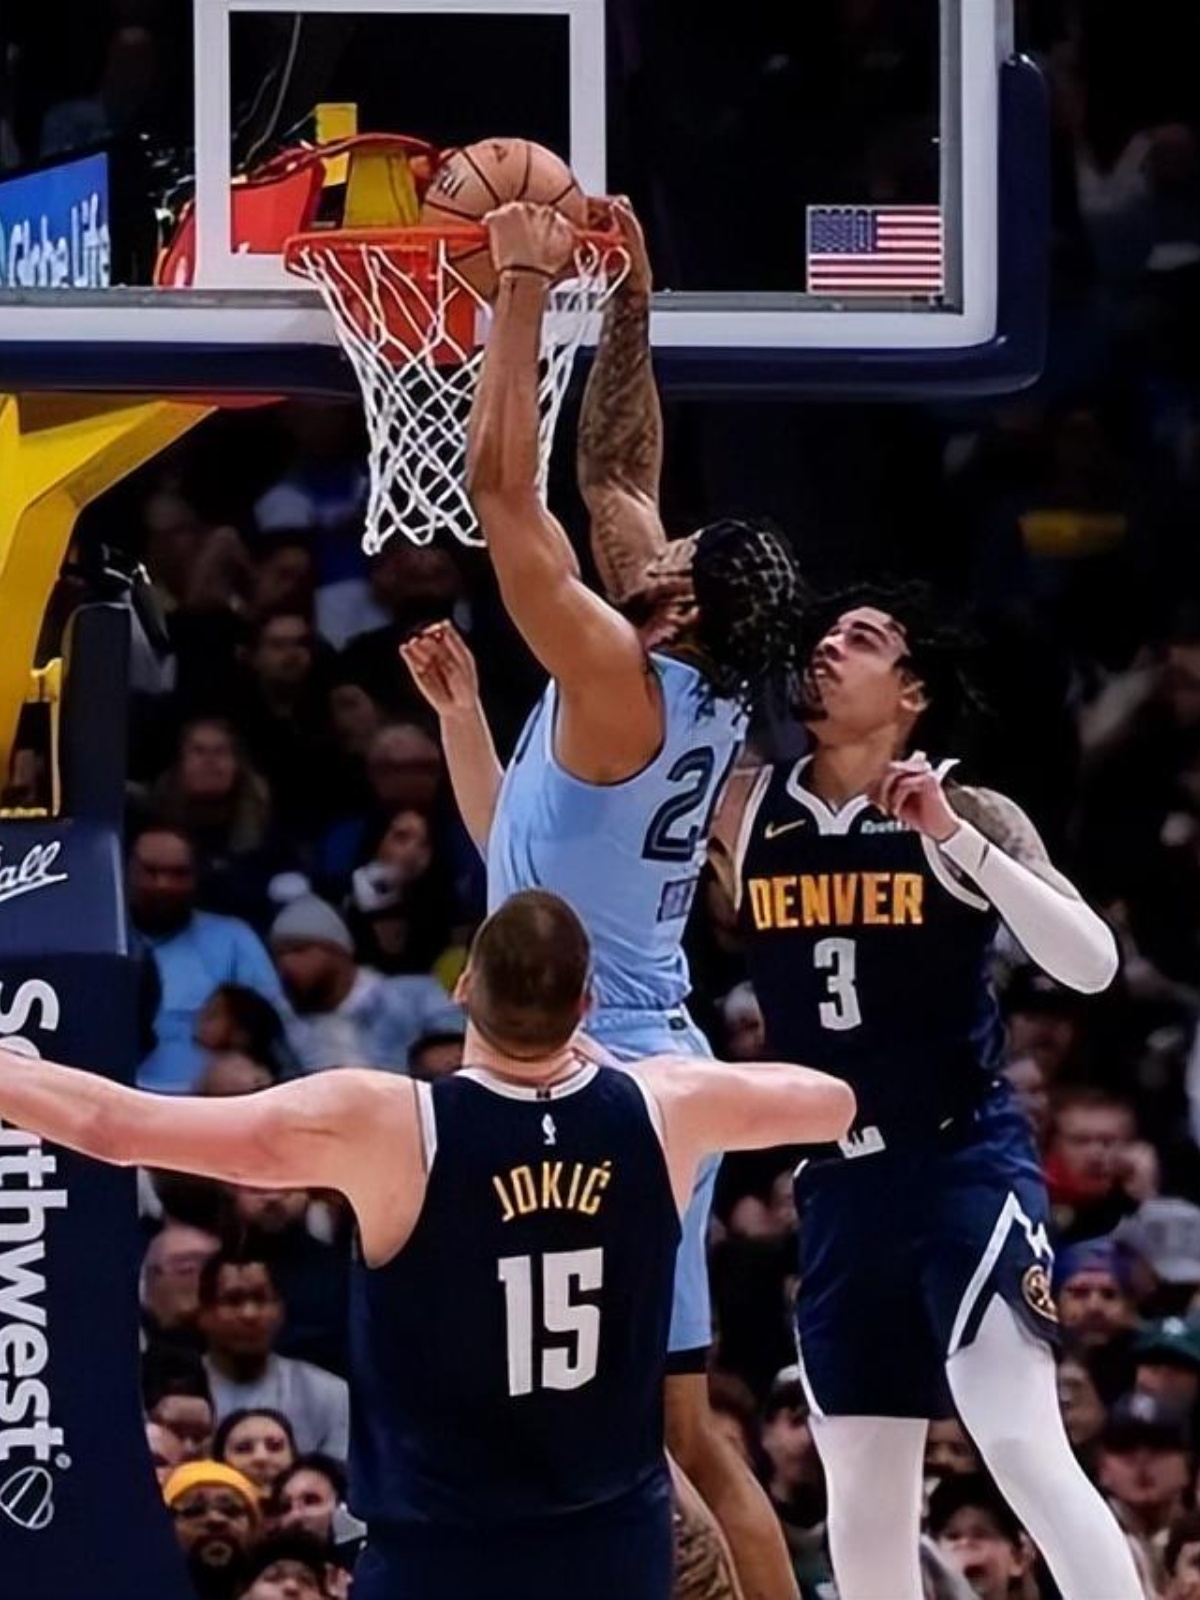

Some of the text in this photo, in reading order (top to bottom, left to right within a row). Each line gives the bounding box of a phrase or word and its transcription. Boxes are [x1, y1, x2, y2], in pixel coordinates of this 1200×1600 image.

[0, 840, 68, 902] all
[748, 872, 924, 930] DENVER
[814, 937, 863, 1031] 3
[492, 1160, 612, 1223] JOKIĆ
[498, 1247, 603, 1397] 15
